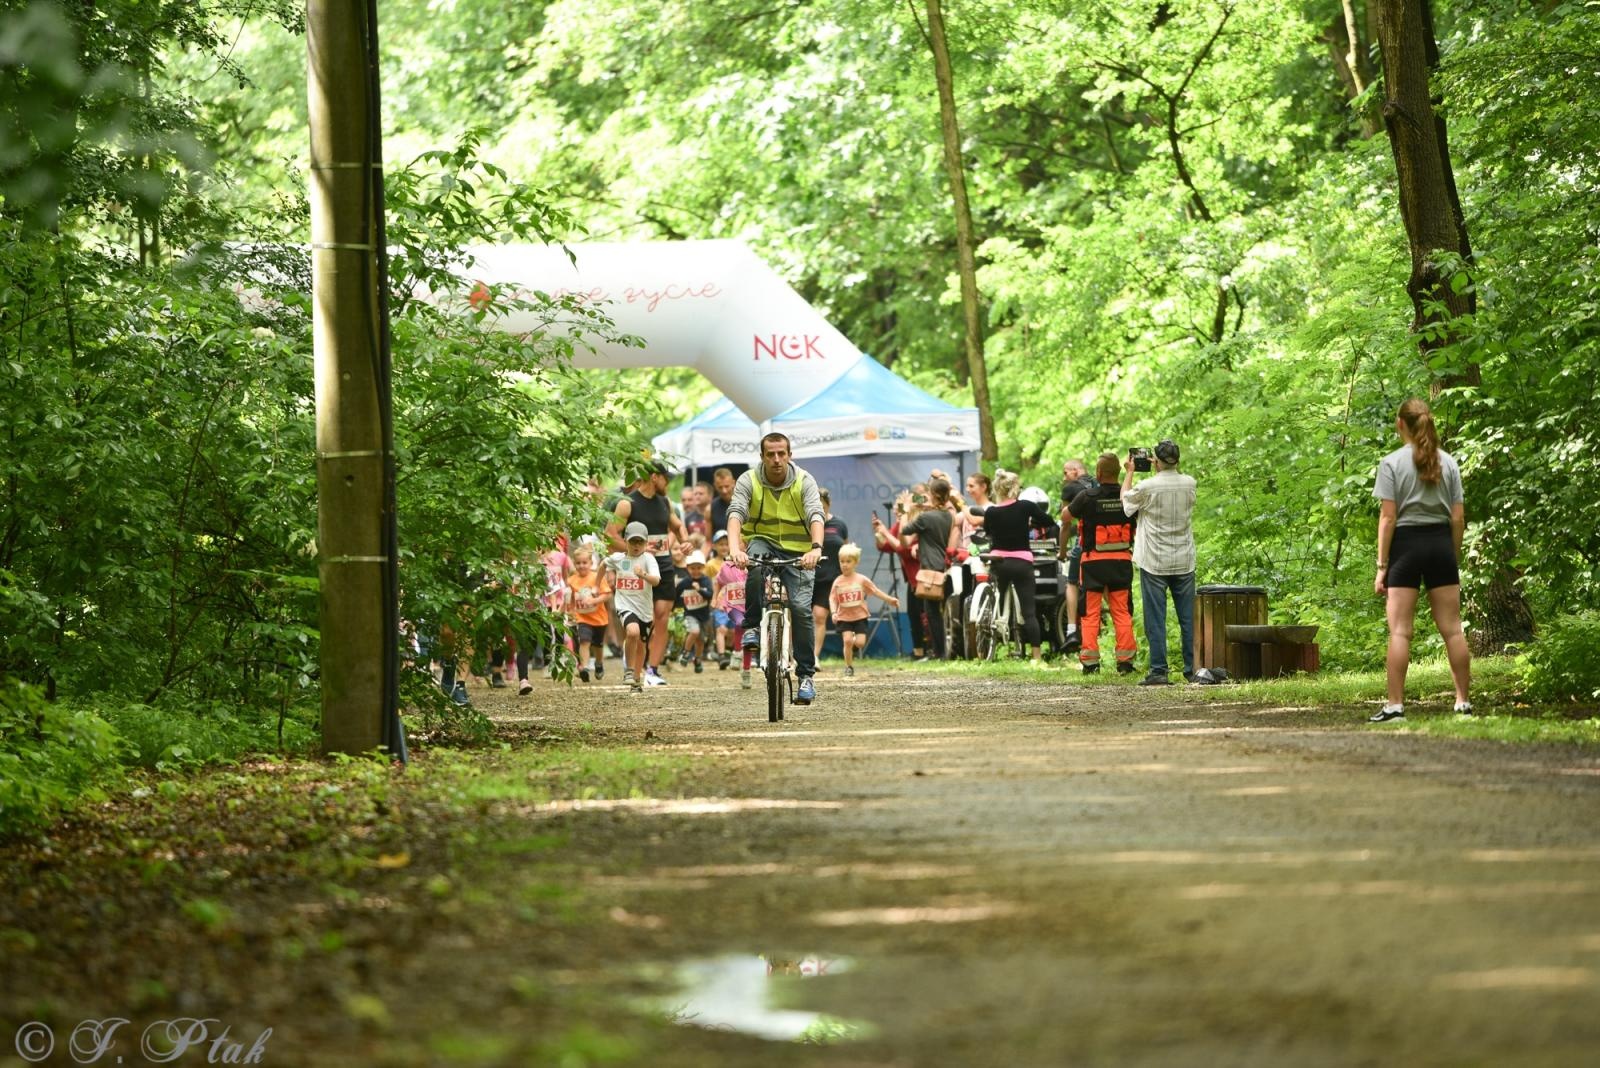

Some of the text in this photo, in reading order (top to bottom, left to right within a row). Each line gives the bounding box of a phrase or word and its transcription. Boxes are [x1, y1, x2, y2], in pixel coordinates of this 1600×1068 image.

[753, 333, 825, 360] NCK
[620, 579, 640, 590] 156
[731, 589, 745, 600] 13
[842, 592, 859, 602] 137
